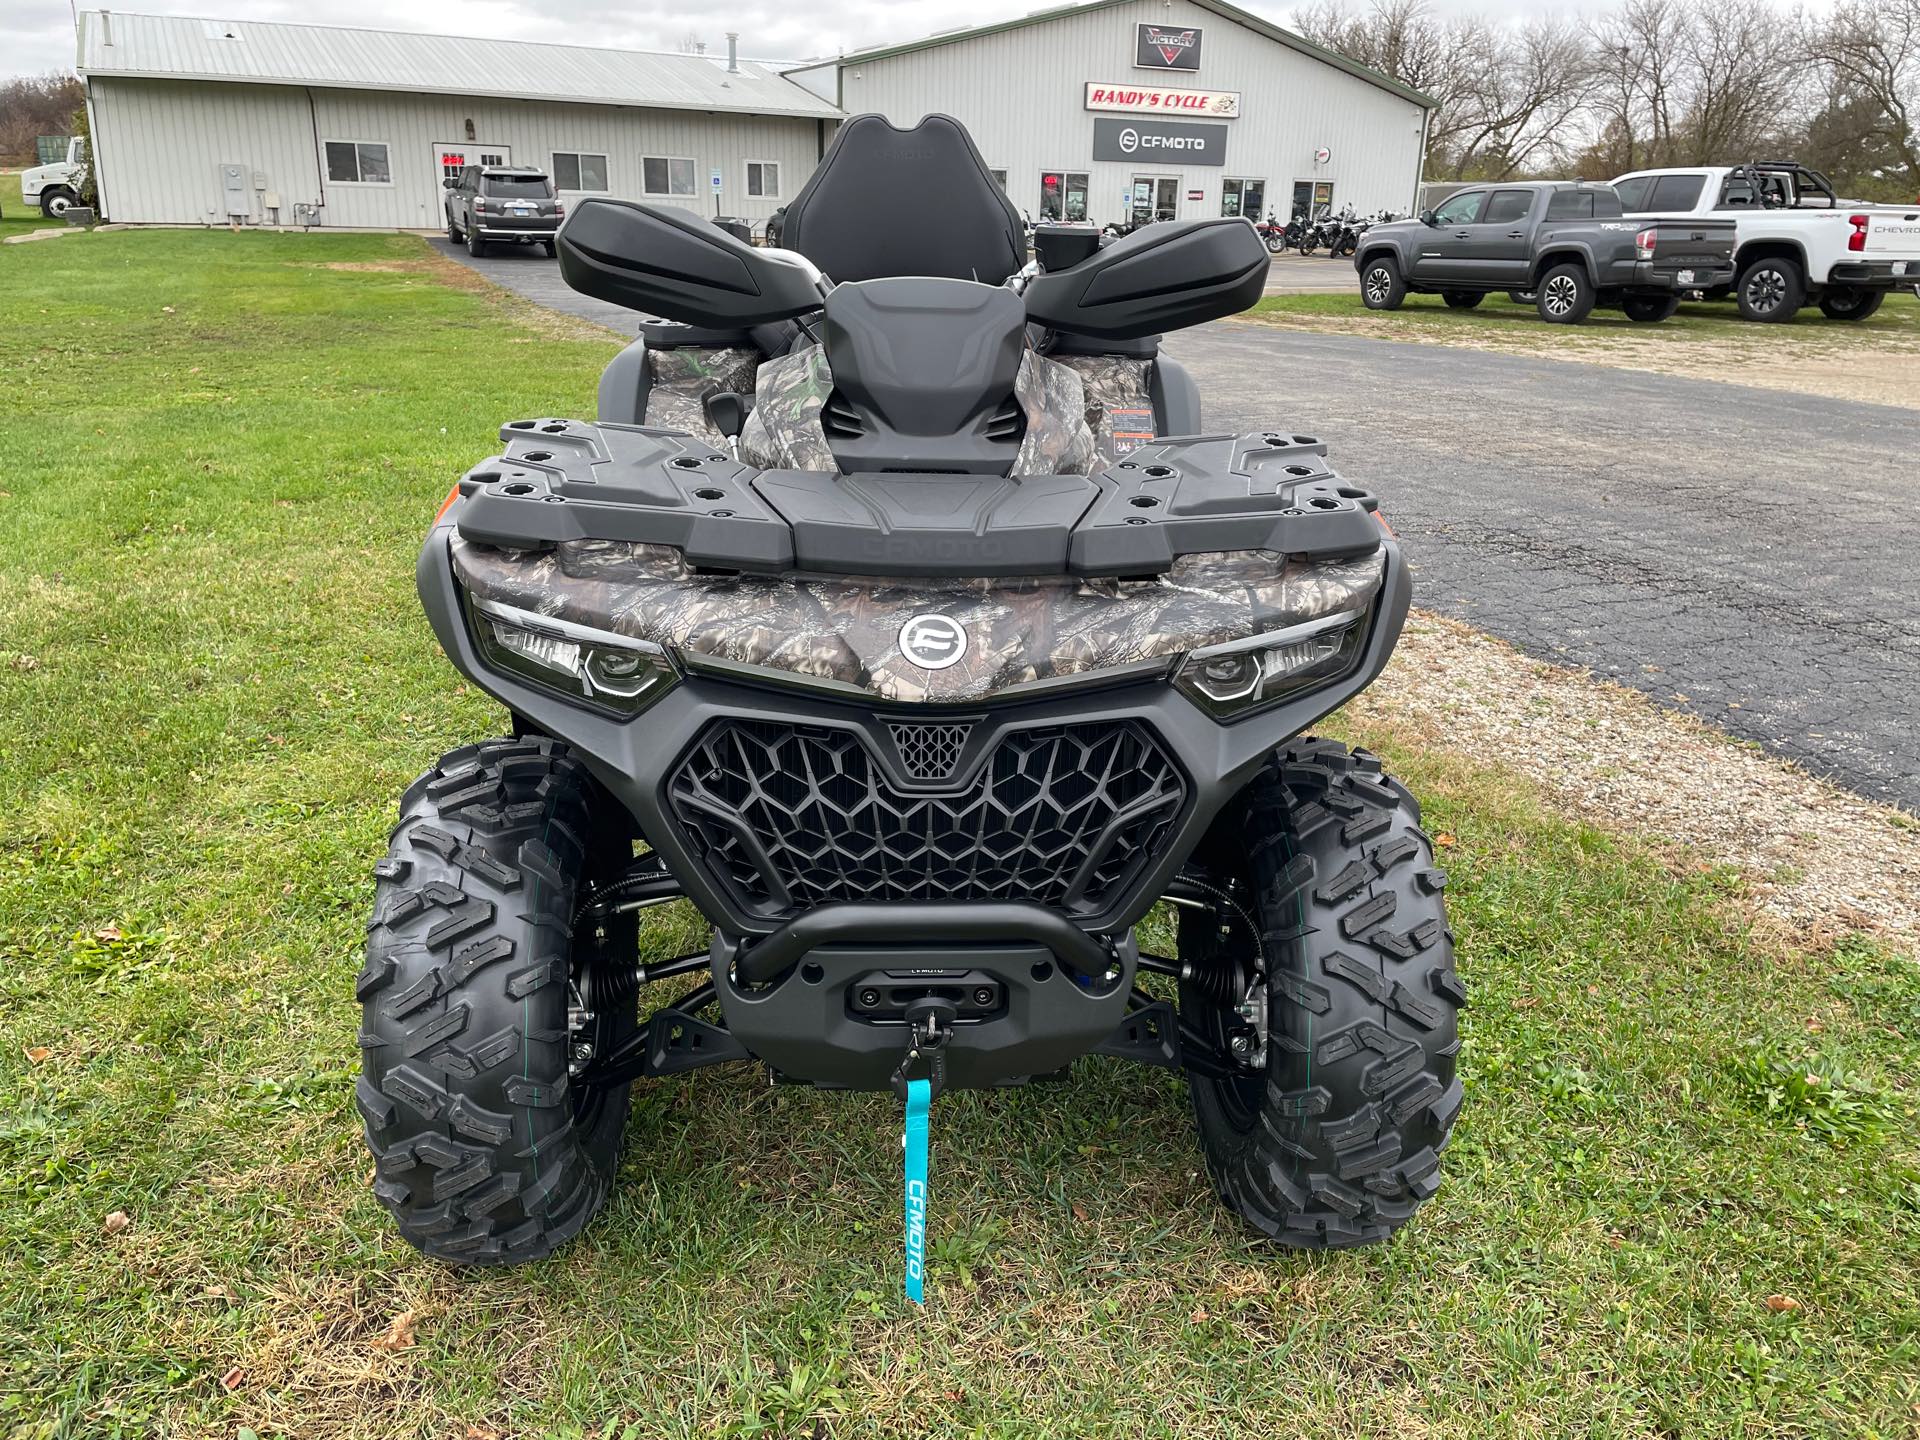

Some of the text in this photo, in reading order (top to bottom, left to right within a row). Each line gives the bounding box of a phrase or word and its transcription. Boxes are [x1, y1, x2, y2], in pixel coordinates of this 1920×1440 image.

[1148, 34, 1194, 46] VICTORY
[1092, 89, 1209, 109] RANDY'S CYCLE
[1141, 135, 1205, 150] CFMOTO
[863, 536, 1003, 558] CFMOTO
[908, 1179, 924, 1281] CFMOTO
